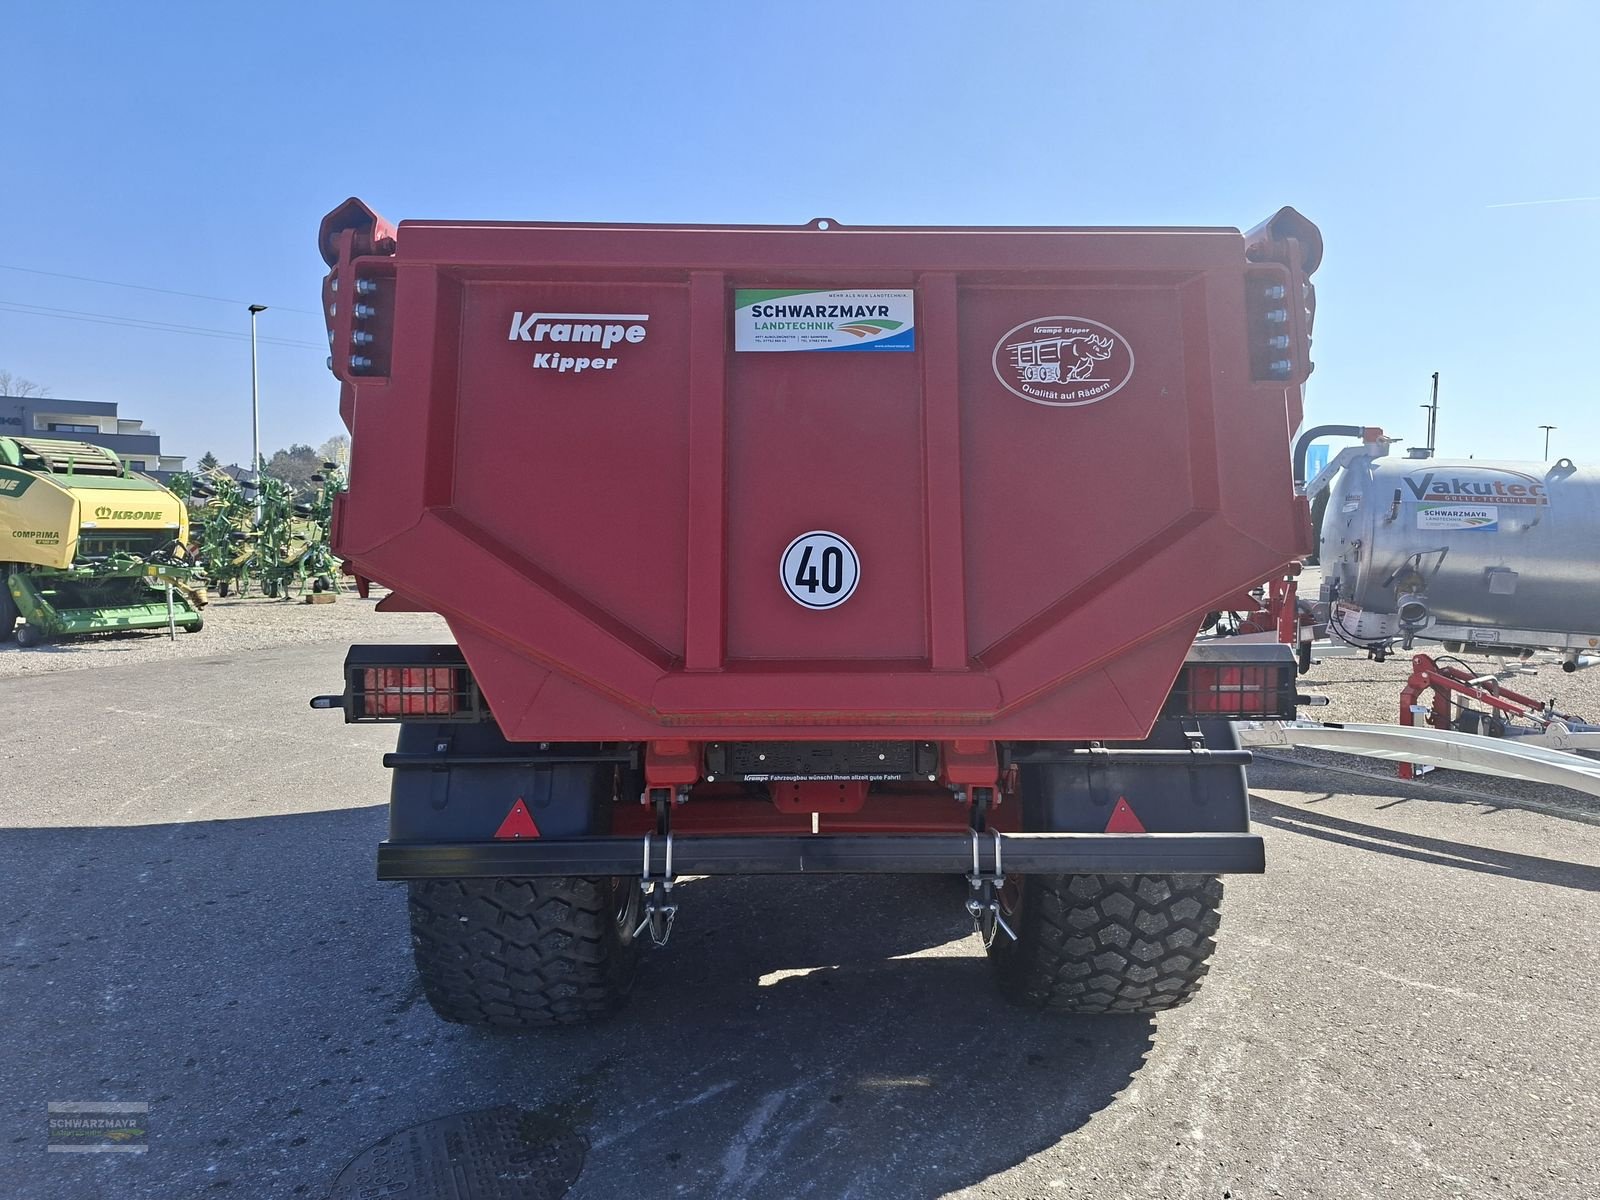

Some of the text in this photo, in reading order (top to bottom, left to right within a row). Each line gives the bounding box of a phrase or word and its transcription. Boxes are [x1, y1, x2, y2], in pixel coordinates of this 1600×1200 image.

[751, 305, 889, 318] SCHWARZMAYR
[508, 311, 650, 349] Krampe
[754, 321, 834, 330] LANDTECHNIK
[1033, 326, 1063, 334] Krampe
[533, 352, 618, 373] Kipper
[1021, 382, 1110, 400] Qualität auf Rädern
[1403, 473, 1547, 500] Vakutec
[111, 510, 163, 520] KRONE
[1424, 510, 1487, 518] SCHWARZMAYR
[12, 531, 60, 539] COMPRIMA
[795, 546, 843, 594] 40
[770, 774, 808, 782] Fahrzeugbau
